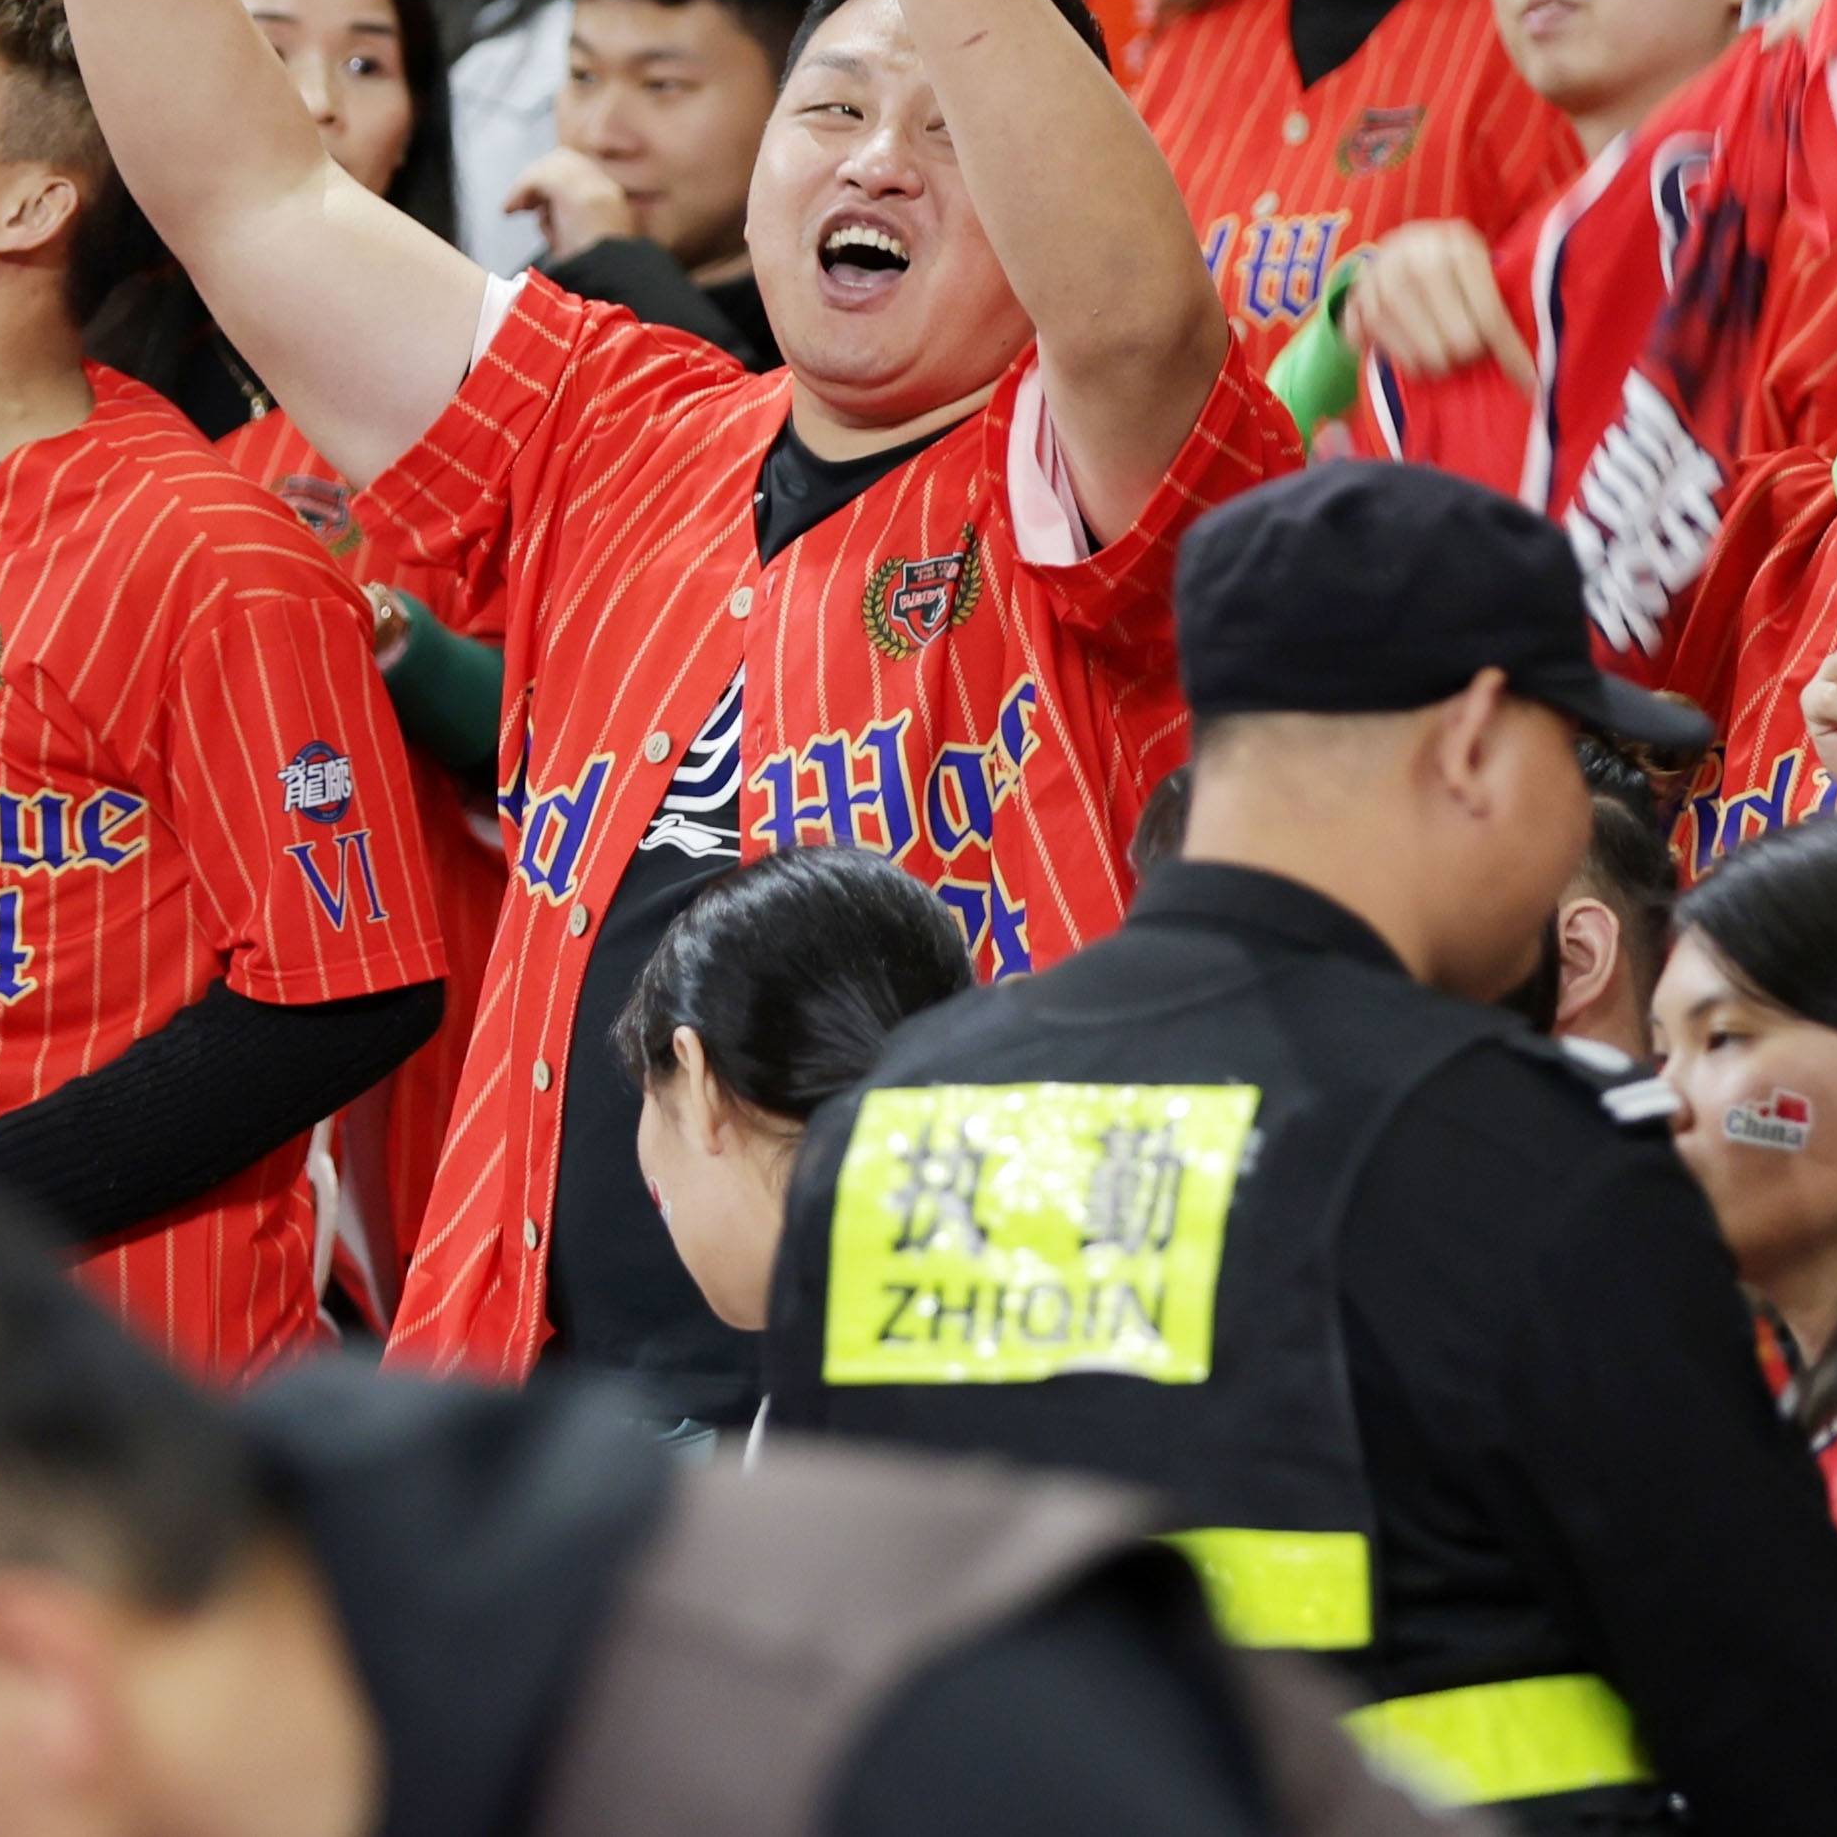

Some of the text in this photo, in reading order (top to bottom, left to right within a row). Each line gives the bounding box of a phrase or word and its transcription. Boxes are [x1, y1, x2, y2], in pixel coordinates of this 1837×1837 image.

[283, 828, 390, 933] VI
[883, 1117, 1185, 1254] 执勤
[875, 1277, 1168, 1346] ZHIQIN
